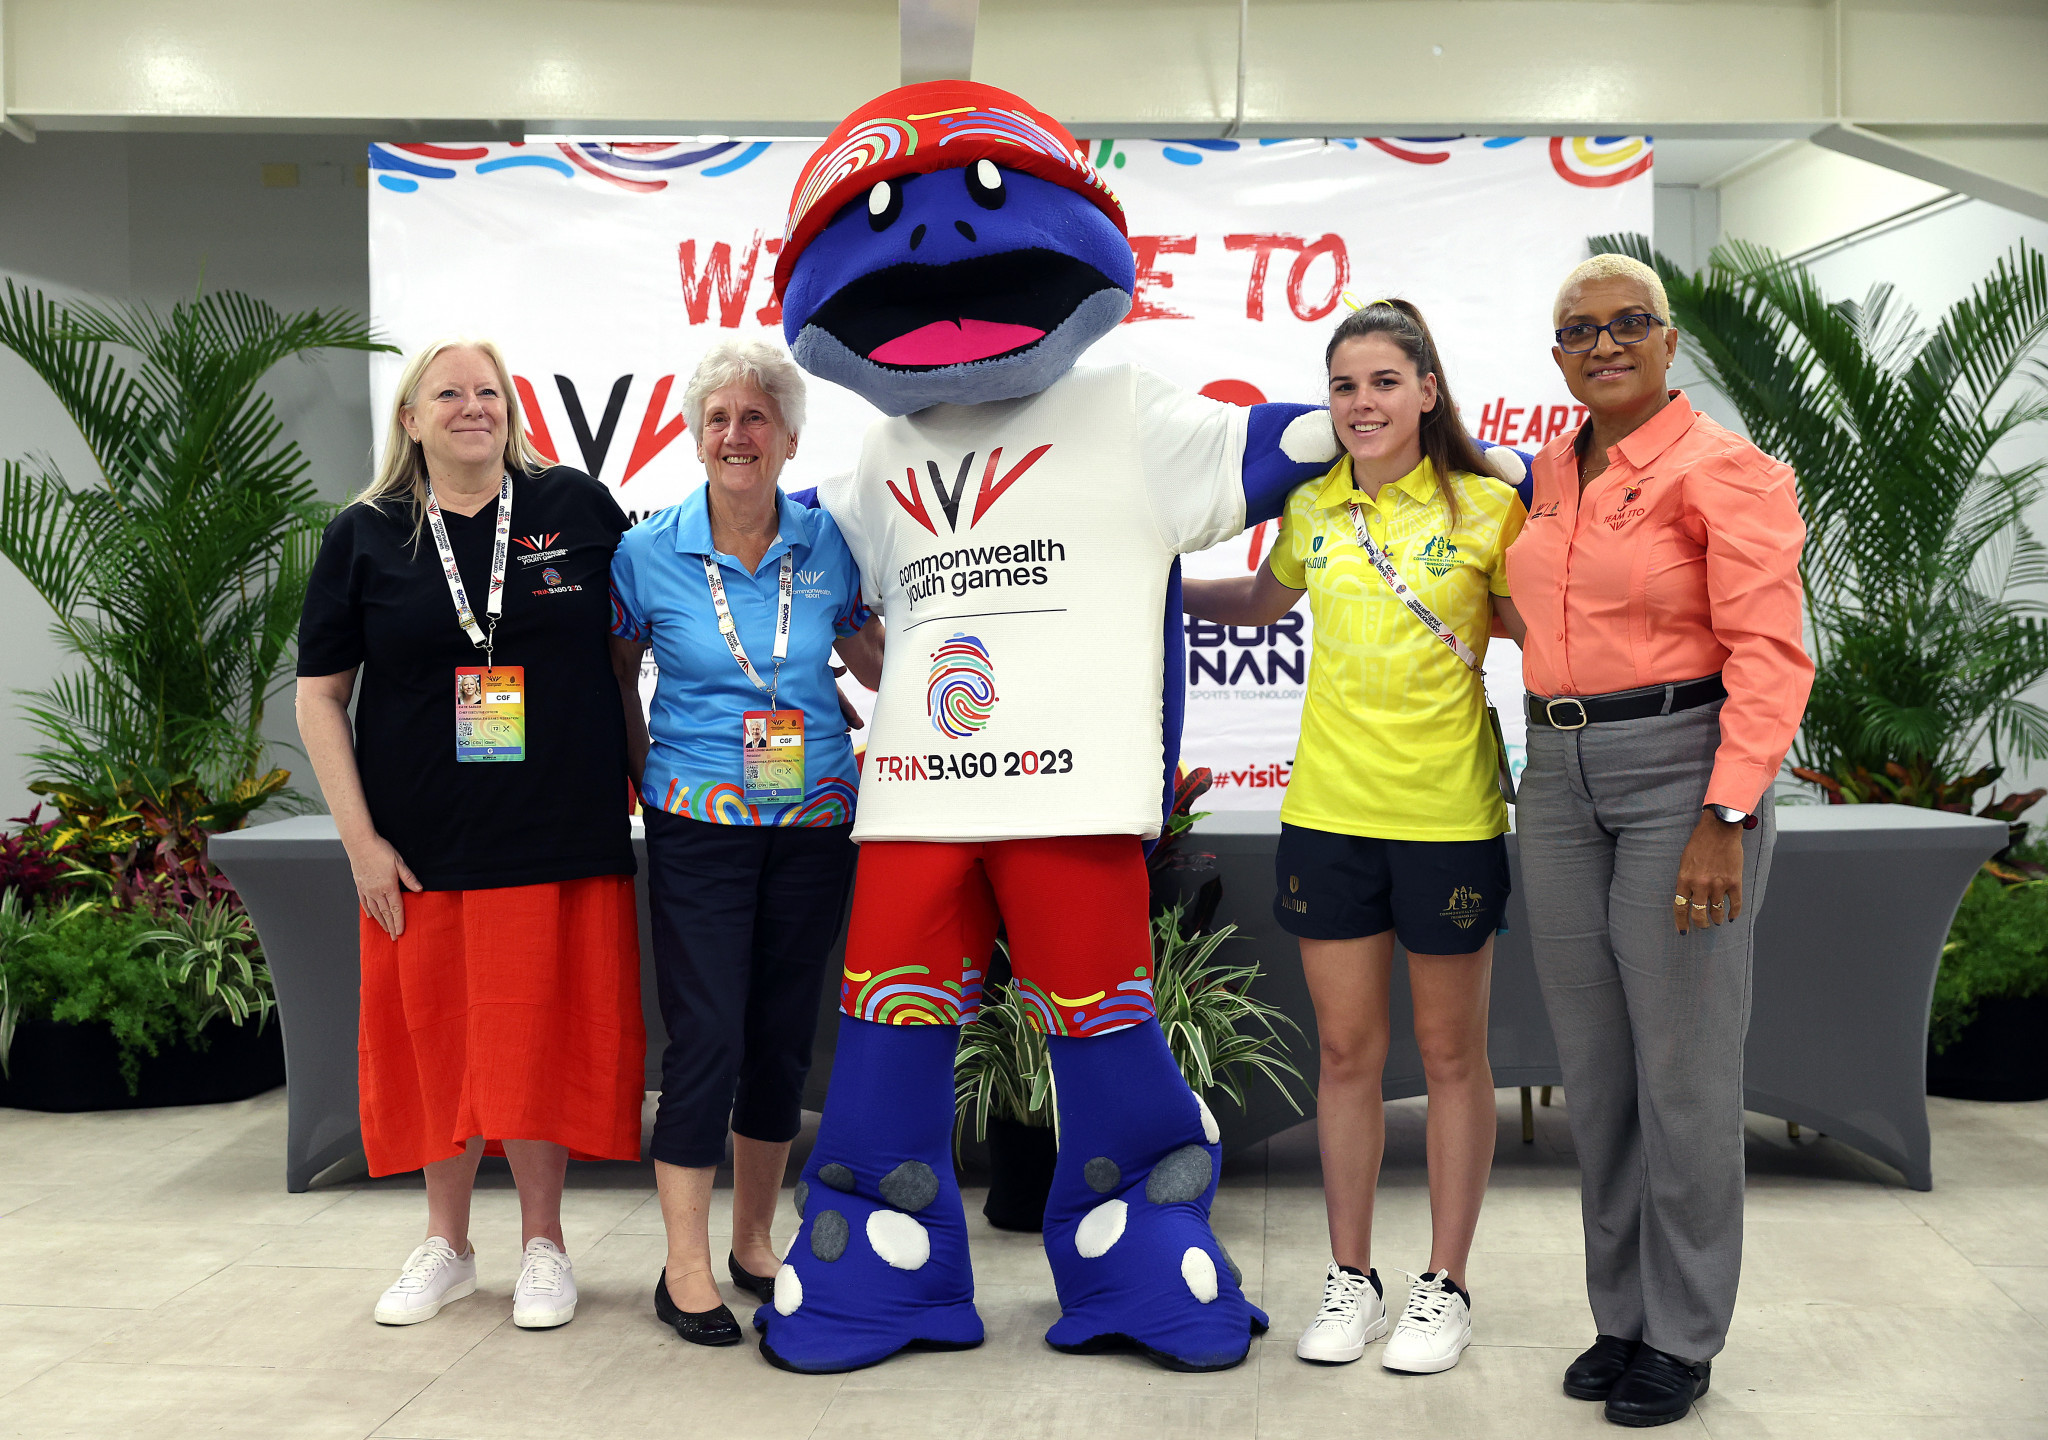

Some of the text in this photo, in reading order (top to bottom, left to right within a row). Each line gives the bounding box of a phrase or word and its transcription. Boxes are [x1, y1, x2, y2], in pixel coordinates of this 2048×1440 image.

[1224, 232, 1350, 321] TO
[1603, 508, 1644, 523] TEAM TTO
[522, 556, 541, 565] youth
[899, 538, 1066, 587] commonwealth
[906, 566, 1048, 611] youth games
[1190, 650, 1304, 685] NAN
[1190, 690, 1305, 700] SPORTS TECHNOLOGY
[1003, 748, 1073, 777] 2023
[1282, 894, 1307, 914] VALOUR
